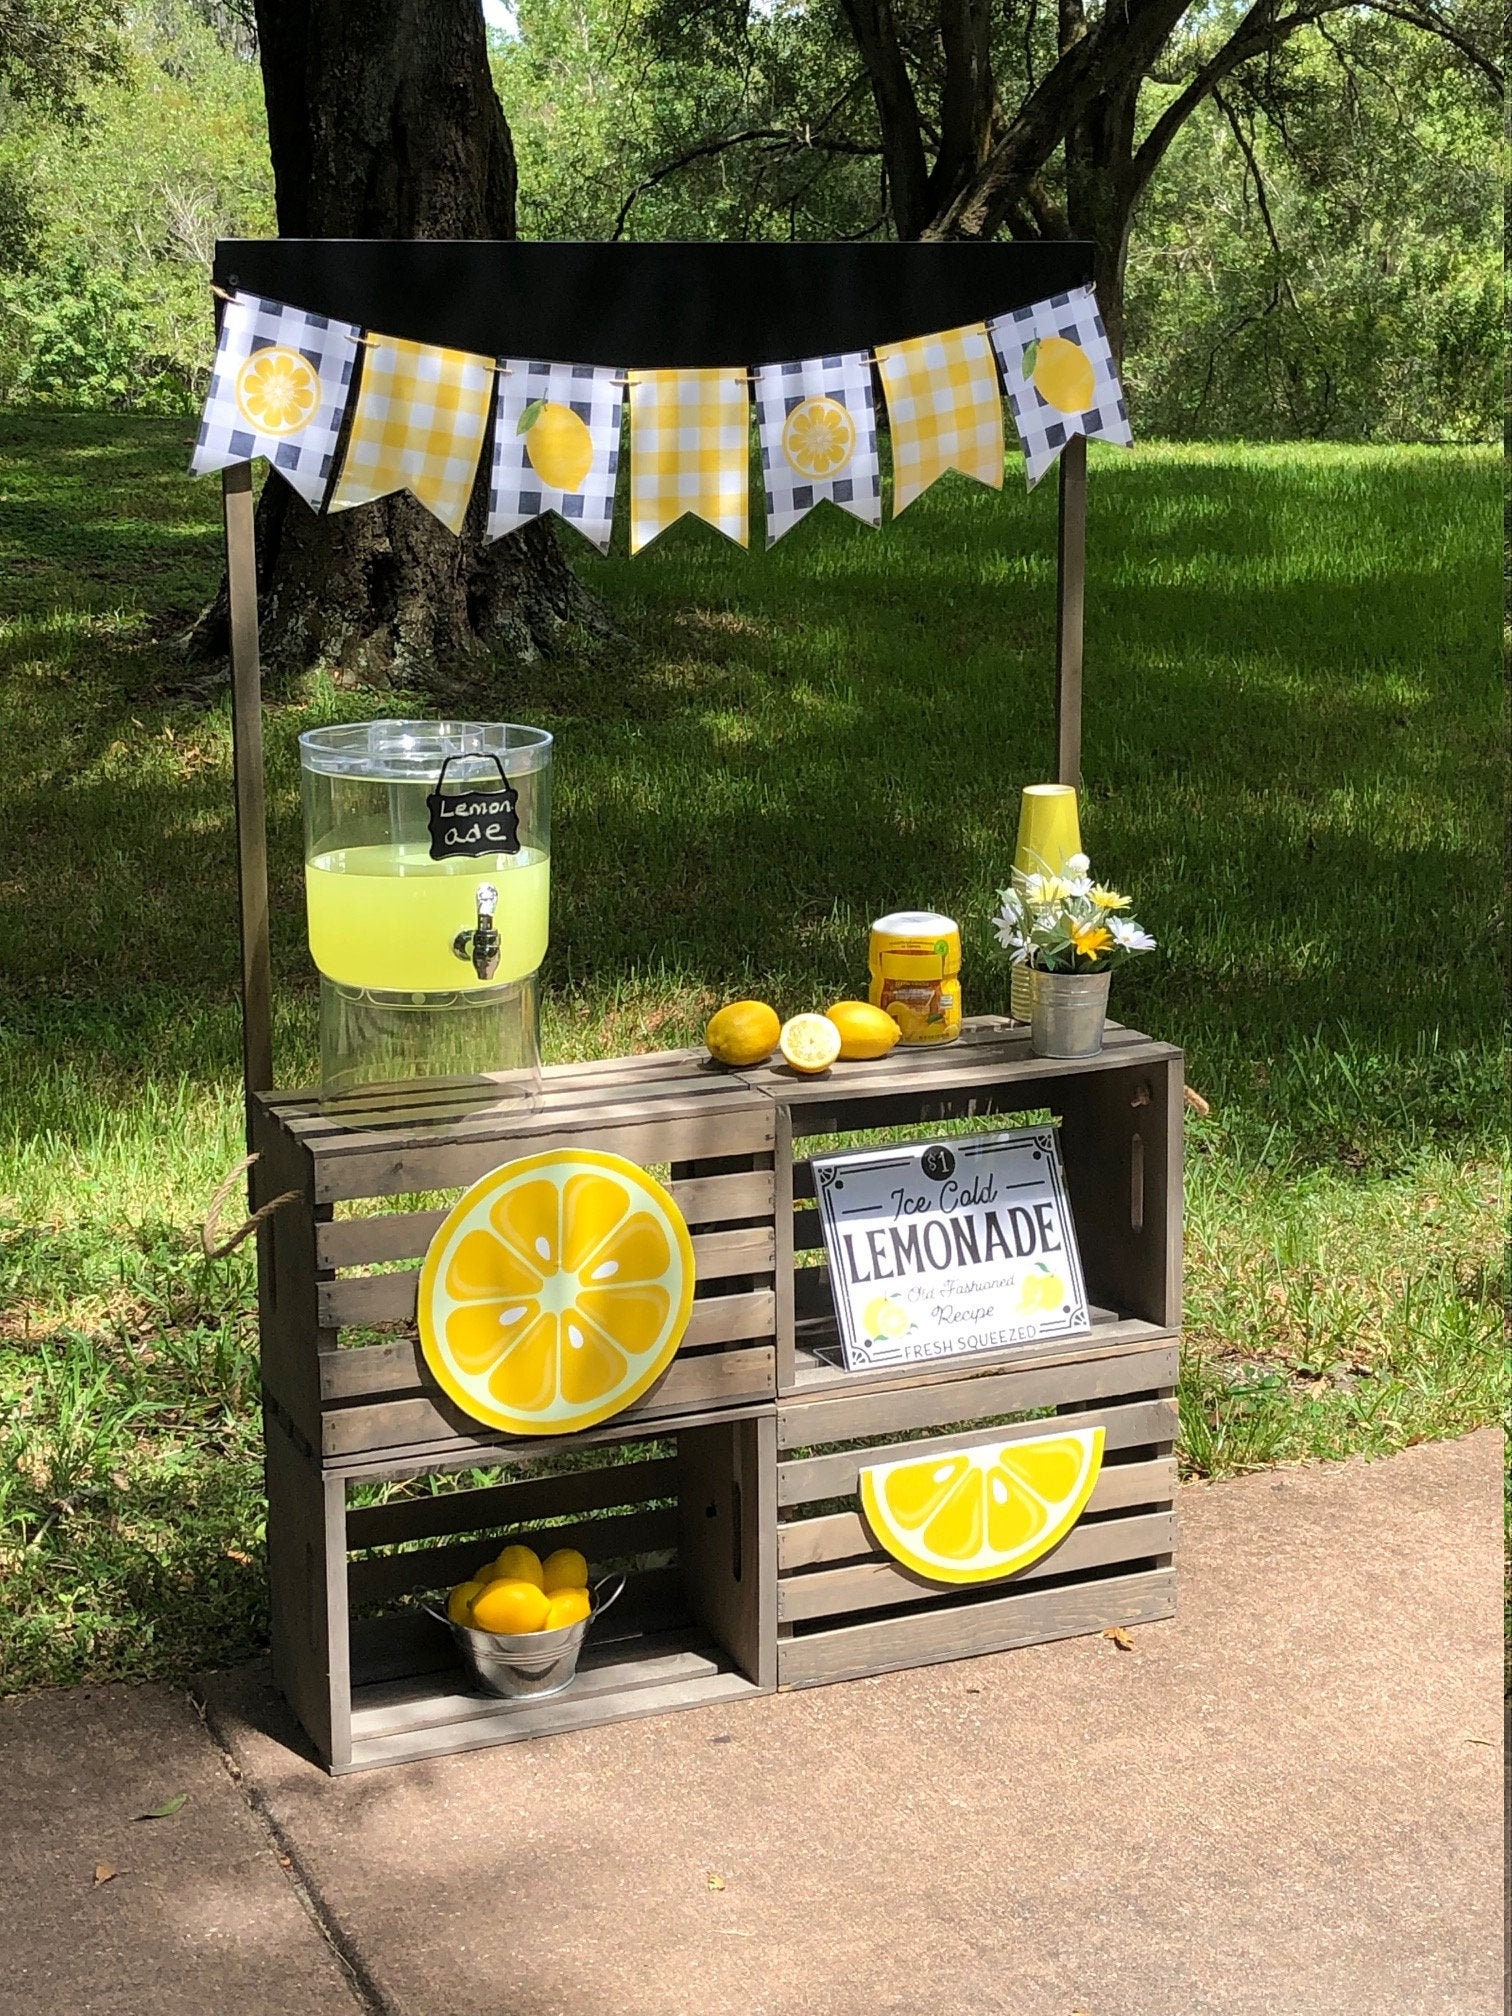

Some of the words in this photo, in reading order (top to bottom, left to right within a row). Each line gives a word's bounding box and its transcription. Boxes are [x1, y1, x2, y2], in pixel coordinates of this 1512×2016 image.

[444, 823, 507, 845] ade
[926, 1151, 950, 1173] $1
[890, 1187, 932, 1221] Ice
[939, 1172, 998, 1214] Cold
[843, 1202, 1061, 1284] LEMONADE
[907, 1286, 935, 1303] Old
[939, 1273, 1015, 1298] Fashioned
[931, 1304, 994, 1325] Recipe
[904, 1340, 953, 1360] FRESH
[957, 1325, 1037, 1351] SQUEEZED
